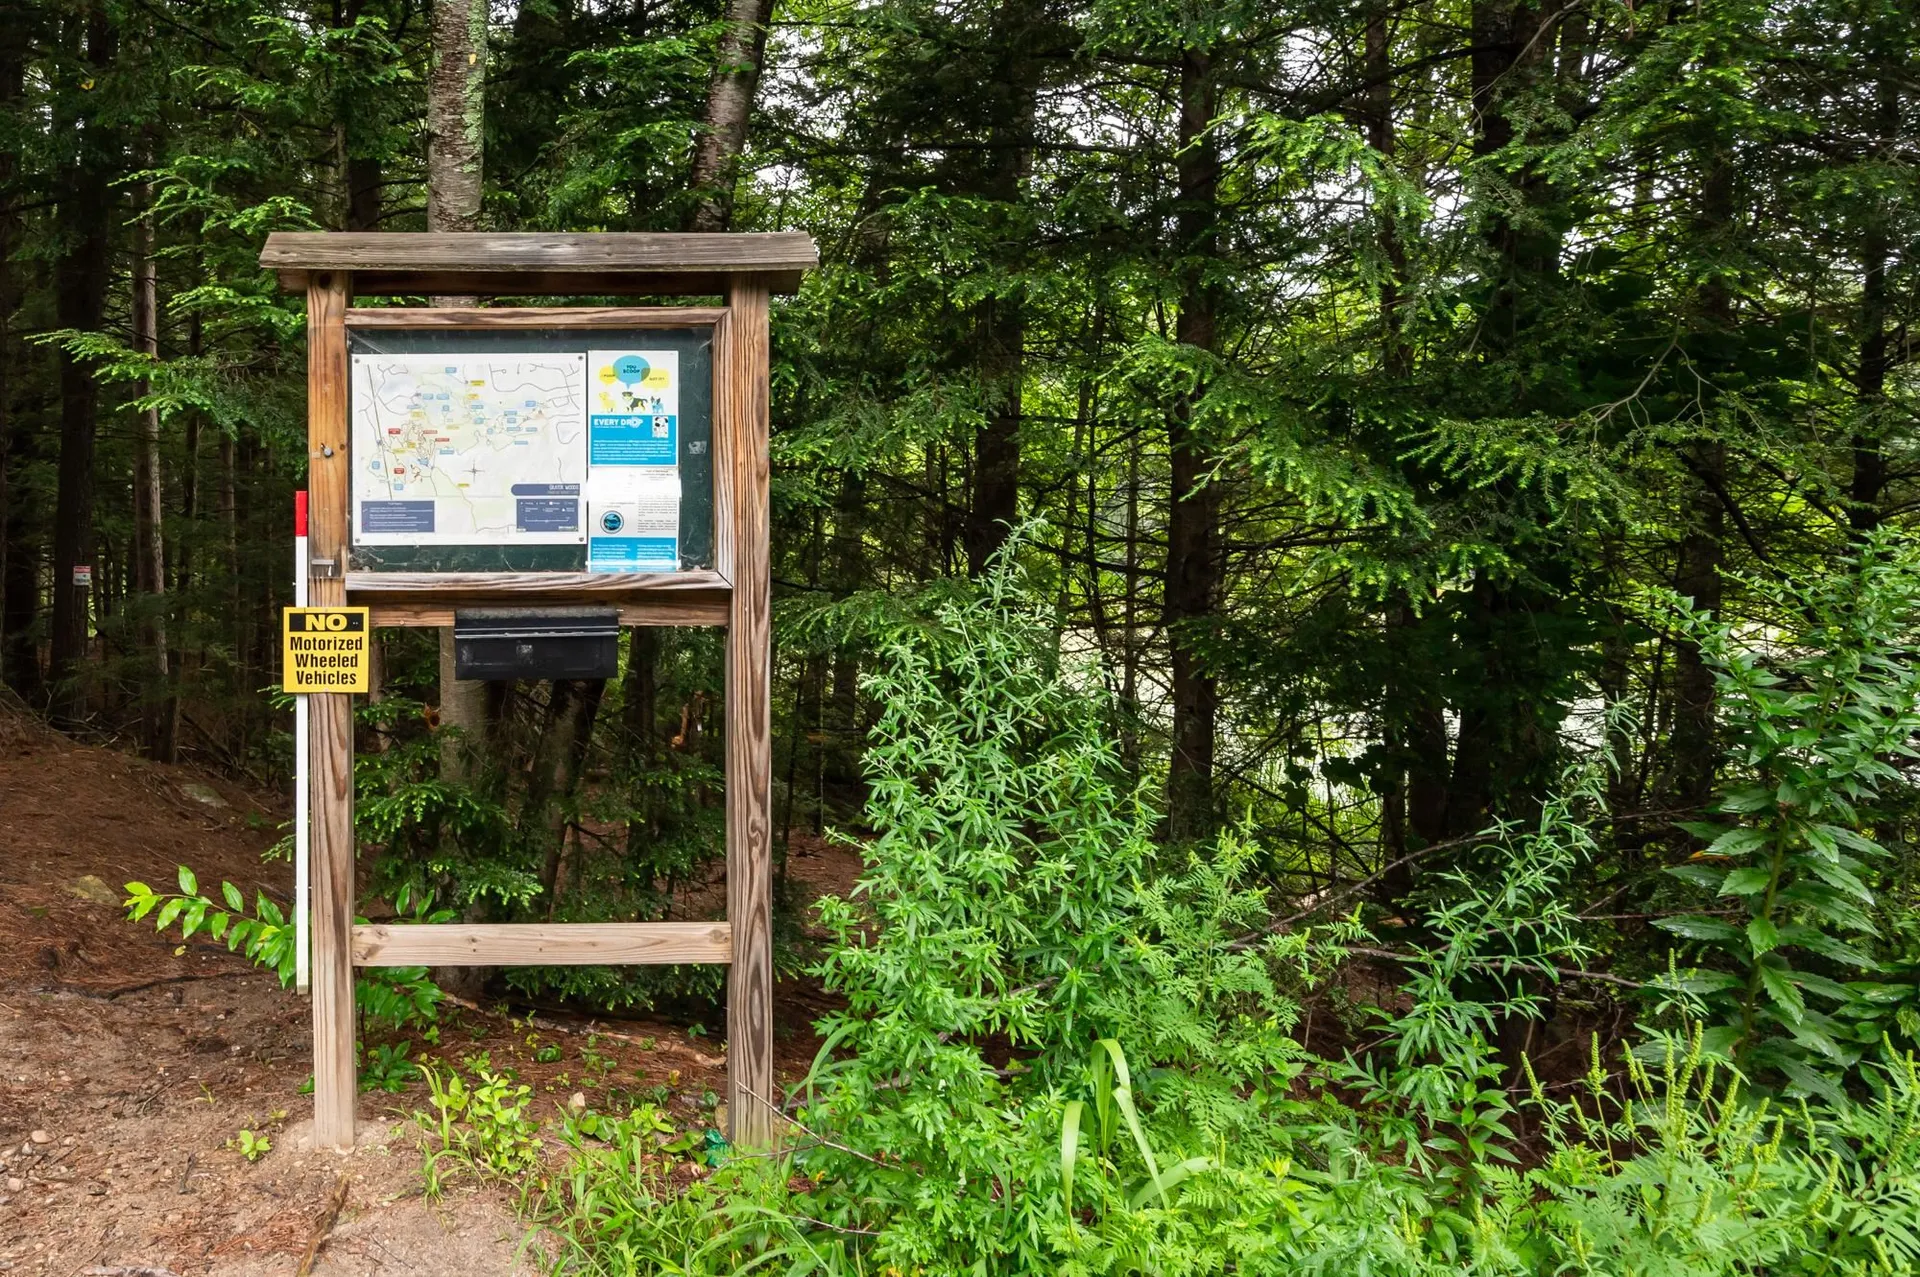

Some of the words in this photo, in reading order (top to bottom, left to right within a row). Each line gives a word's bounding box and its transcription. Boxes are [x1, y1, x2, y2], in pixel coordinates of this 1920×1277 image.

[621, 418, 643, 426] DROP
[305, 614, 347, 631] NO
[290, 636, 363, 651] Motorized
[295, 654, 358, 667] Wheeled
[296, 671, 357, 685] Vehicles
